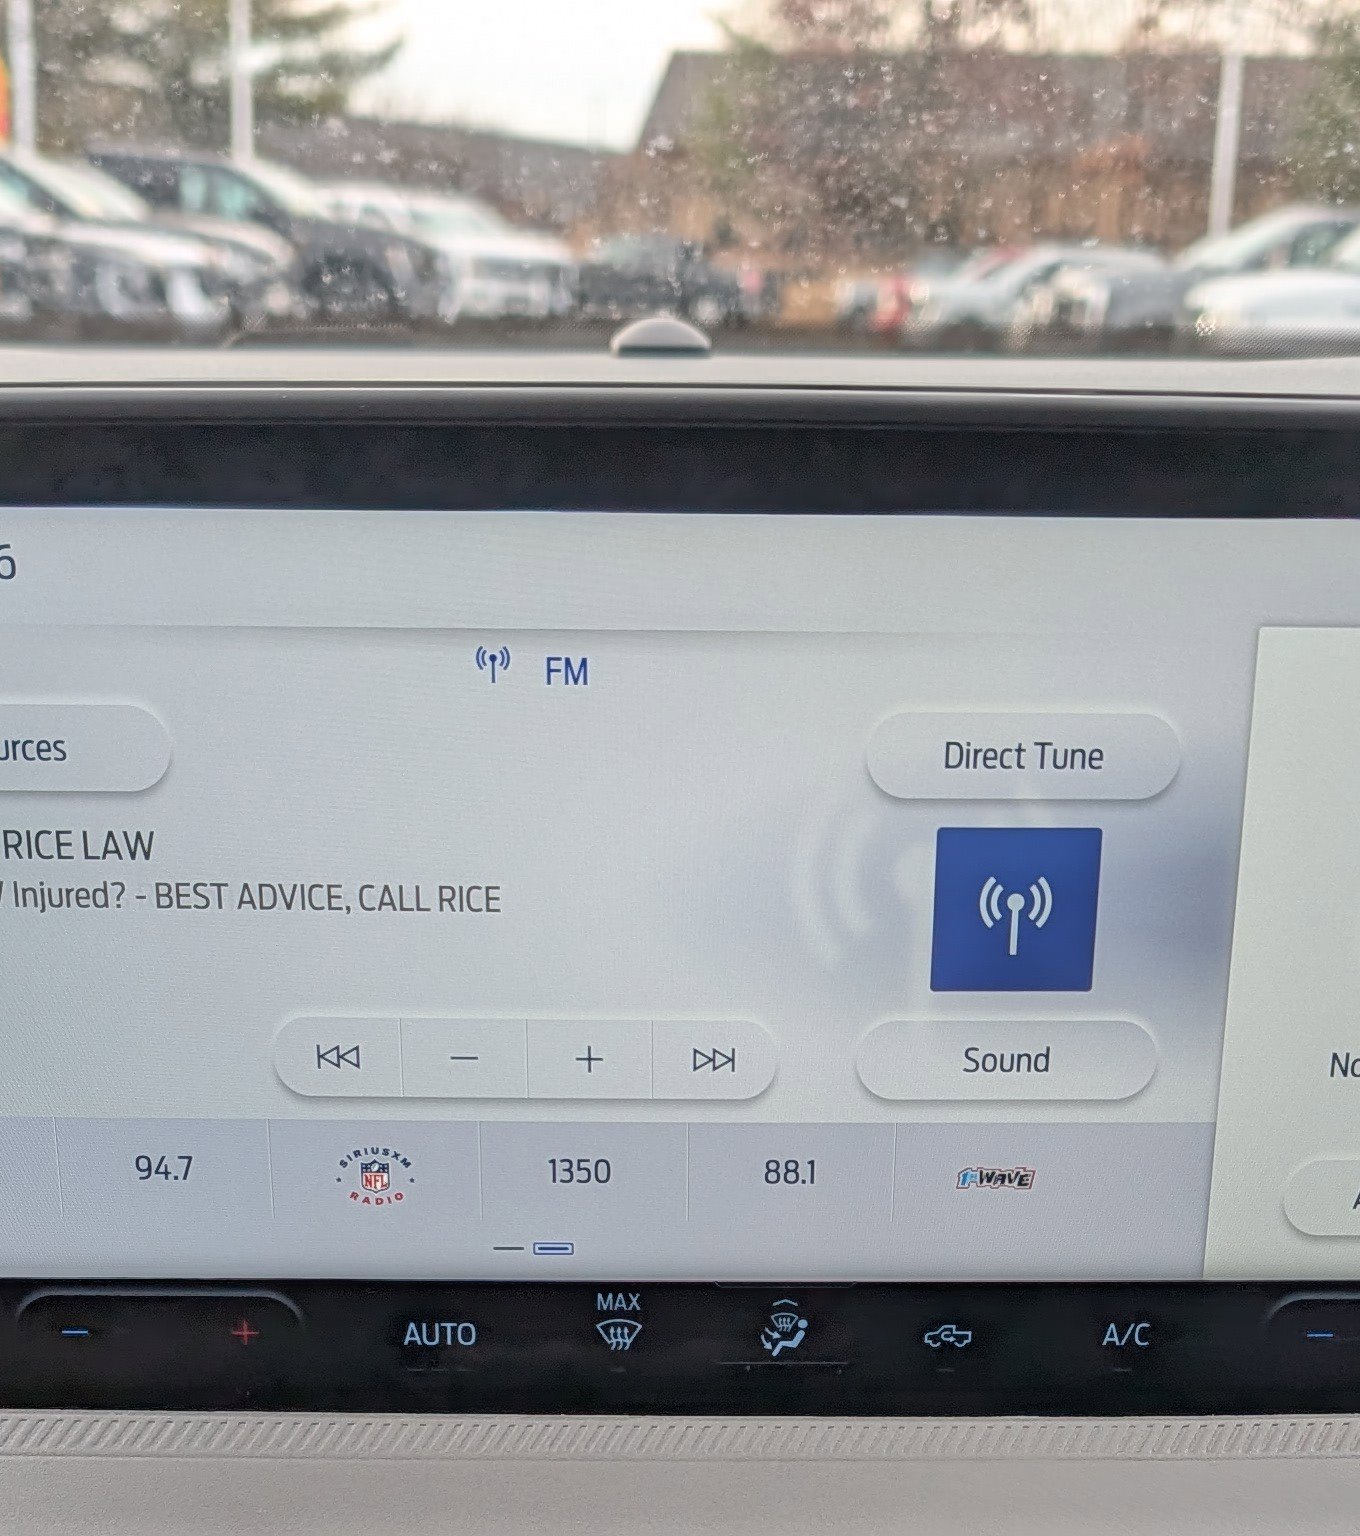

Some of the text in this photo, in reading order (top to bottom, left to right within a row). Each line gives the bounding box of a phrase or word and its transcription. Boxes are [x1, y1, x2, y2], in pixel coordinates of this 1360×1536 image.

[546, 656, 588, 686] FM
[944, 741, 1104, 770] Direct Tune
[2, 829, 75, 860] RICE
[82, 830, 155, 861] LAW
[12, 880, 126, 914] Injured?
[154, 882, 229, 910] BEST
[236, 882, 351, 915] ADVICE,
[358, 883, 432, 912] CALL
[438, 885, 502, 913] RICE
[962, 1045, 1051, 1073] Sound
[135, 1154, 193, 1181] 94.7
[339, 1146, 412, 1169] SIRIUSXM
[364, 1173, 388, 1189] NFL
[548, 1158, 611, 1184] 1350
[764, 1159, 815, 1185] 88.1
[349, 1191, 404, 1205] RADIO
[597, 1292, 641, 1311] MAX
[403, 1322, 477, 1346] AUTO
[1101, 1322, 1151, 1346] A/C
